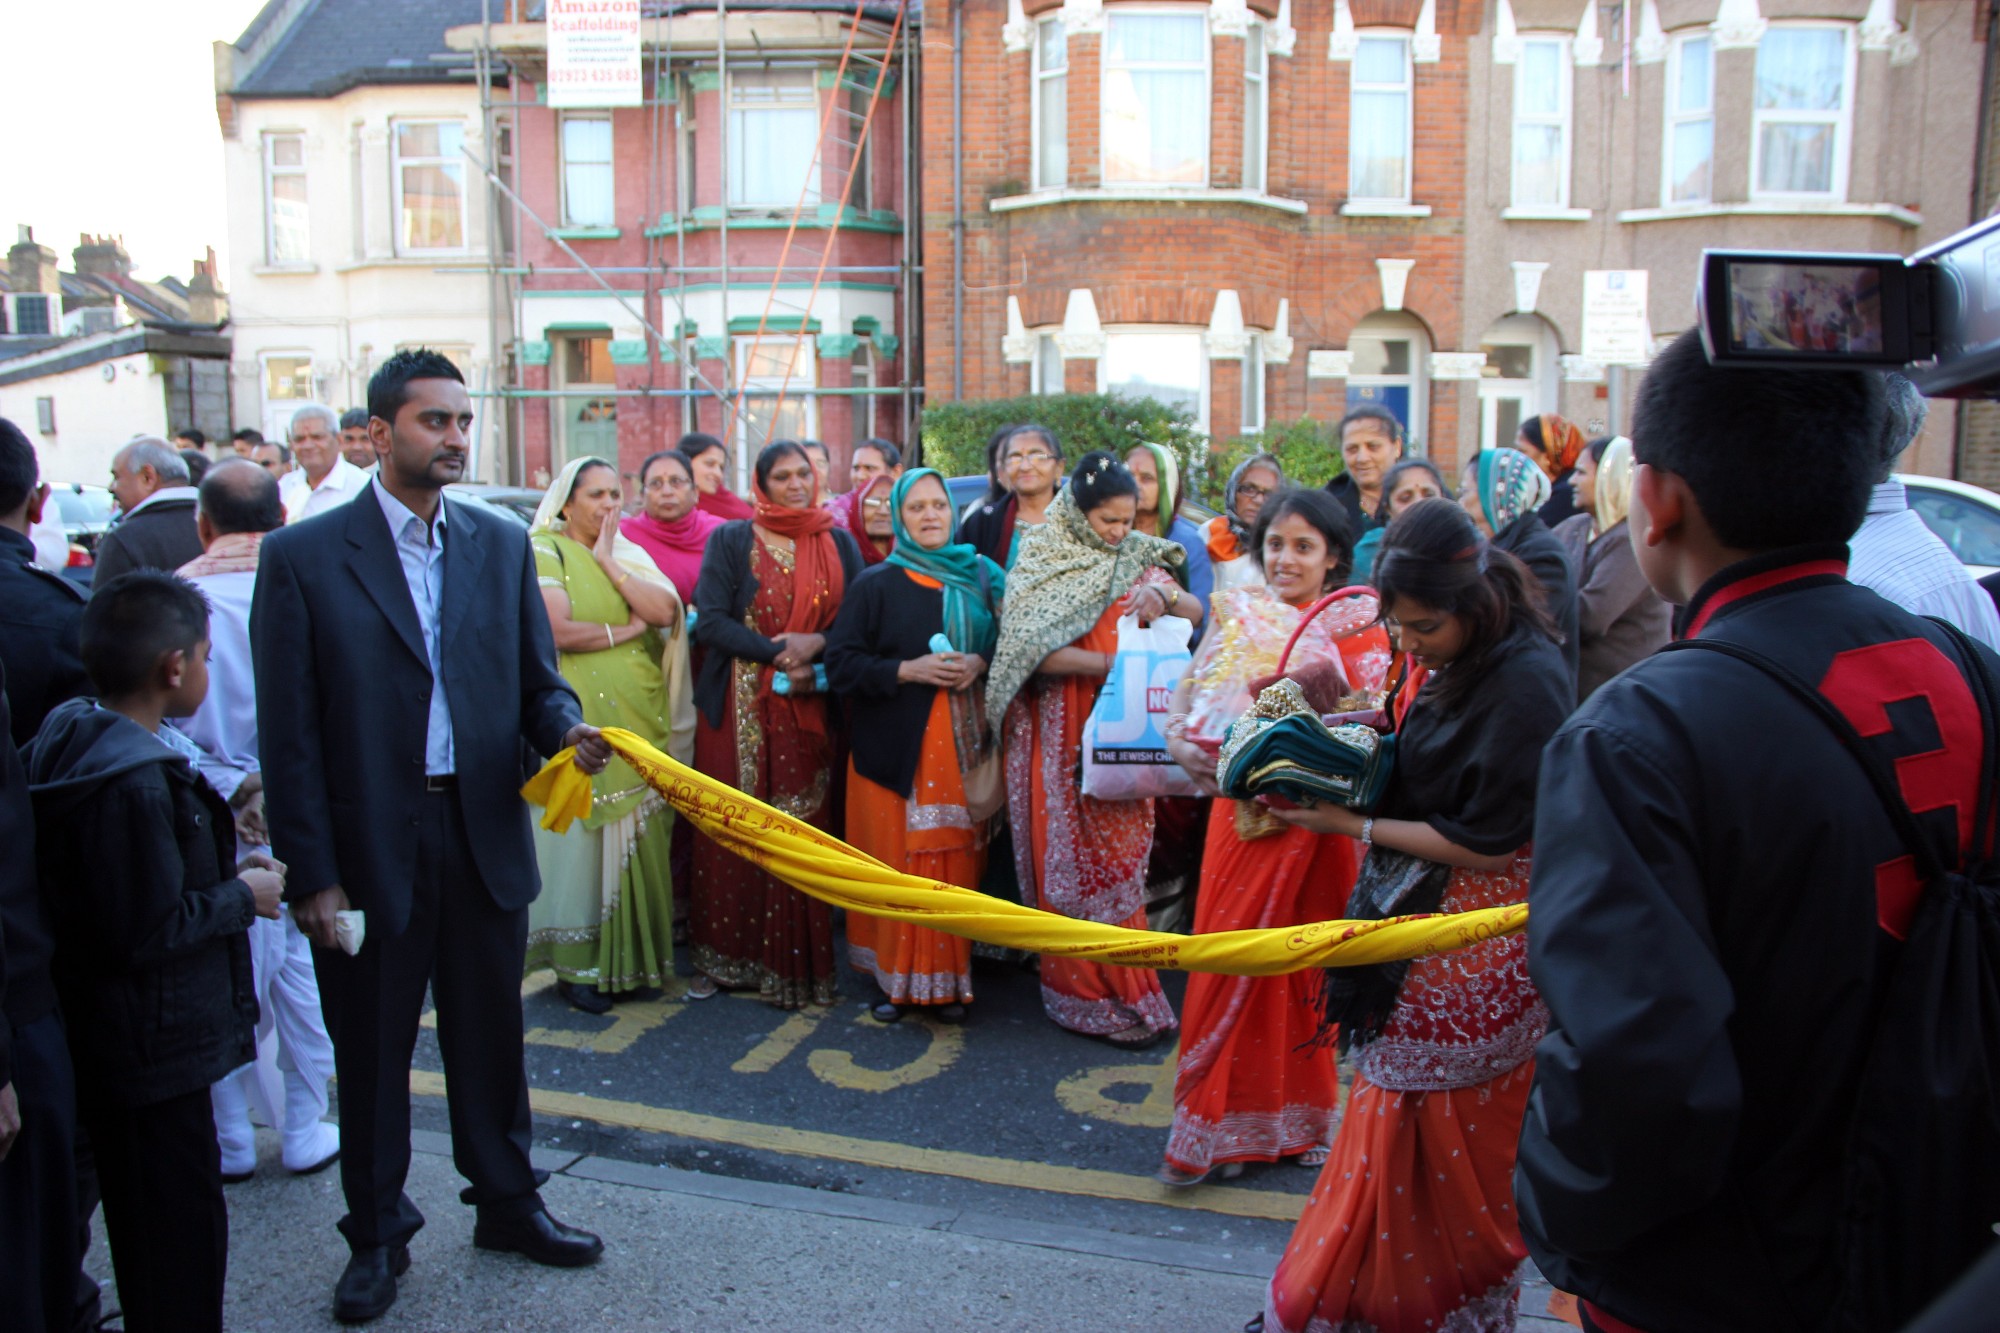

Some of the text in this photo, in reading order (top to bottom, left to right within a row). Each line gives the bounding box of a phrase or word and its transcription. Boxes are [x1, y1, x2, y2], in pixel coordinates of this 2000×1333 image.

[551, 0, 639, 14] Amazon
[552, 17, 638, 34] Scaffolding
[1097, 751, 1117, 761] THE
[1119, 751, 1154, 762] JEWISH
